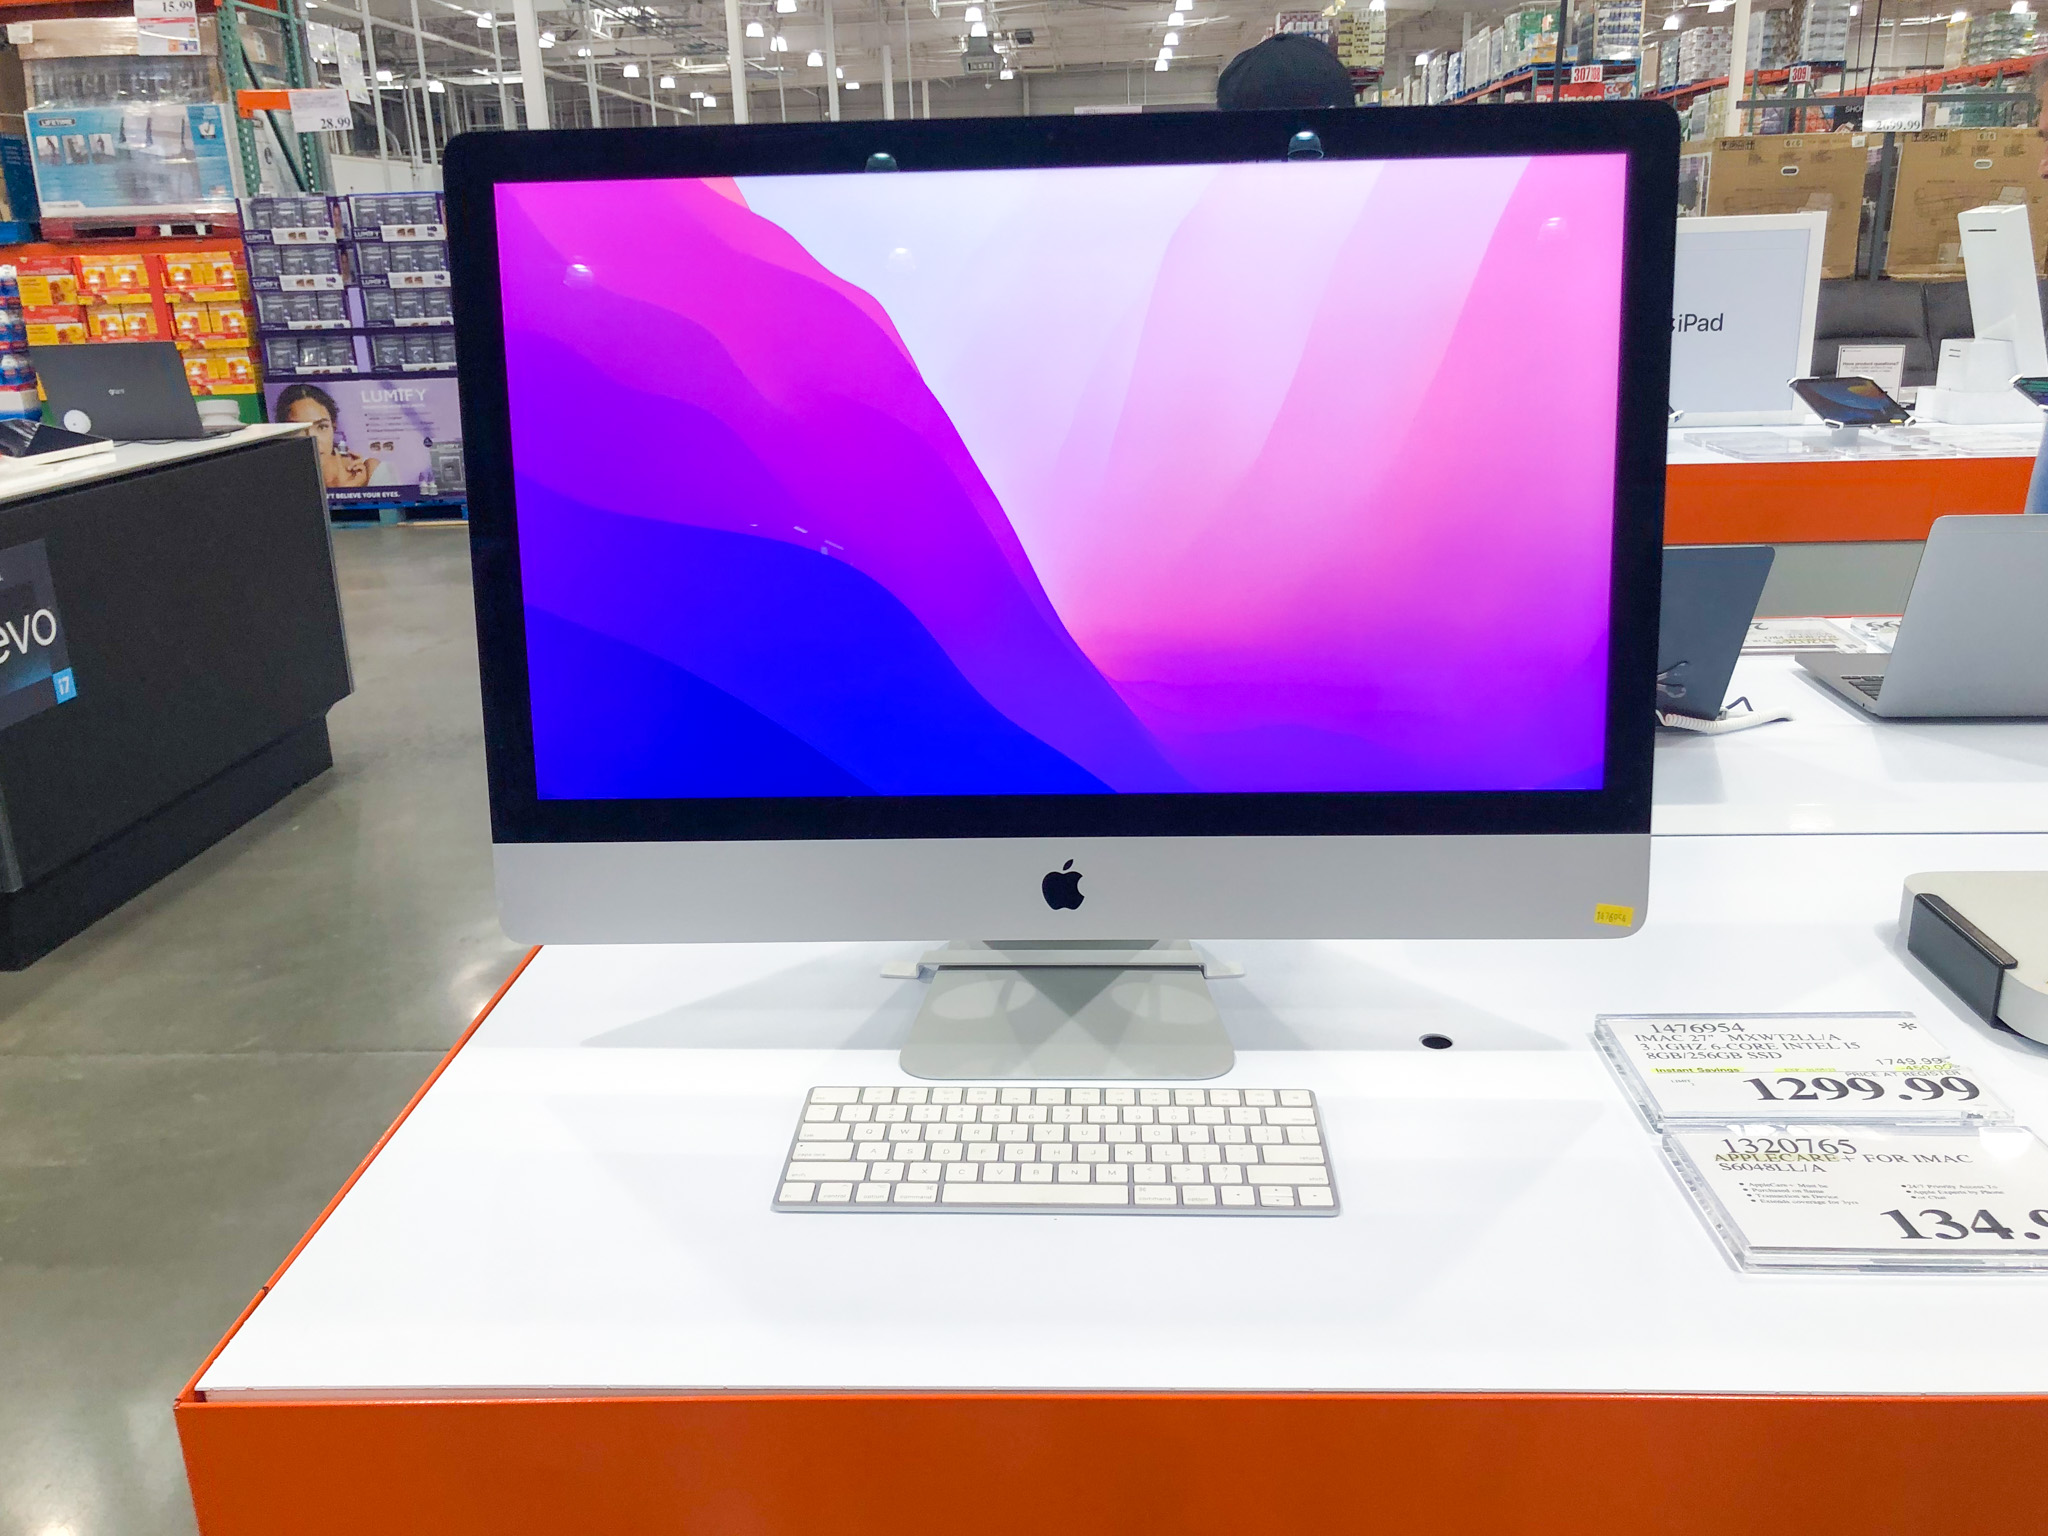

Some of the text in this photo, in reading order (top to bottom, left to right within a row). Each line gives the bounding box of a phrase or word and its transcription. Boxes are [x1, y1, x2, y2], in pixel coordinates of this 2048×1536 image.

[1574, 67, 1590, 82] 307
[1792, 67, 1806, 80] 309
[320, 117, 351, 130] 28.99
[1678, 312, 1724, 332] iPad
[360, 388, 427, 403] LUMIFY
[382, 490, 400, 498] EYES.
[58, 675, 71, 696] i7
[1650, 1023, 1745, 1034] 1476954
[1635, 1034, 1684, 1042] IMAC
[1728, 1033, 1842, 1042] MXWT2LL/A
[1641, 1043, 1706, 1051] 3.1GHZ
[1710, 1042, 1778, 1051] 6-CORE
[1783, 1042, 1841, 1050] INTEL
[1646, 1051, 1783, 1060] 8GB/256GB SSD
[1743, 1076, 1980, 1101] 1299.99
[1720, 1138, 1857, 1155] 1320765
[1862, 1154, 1909, 1163] FOR
[1912, 1154, 1973, 1163] IMAC
[1718, 1162, 1828, 1173] S6048LL/A
